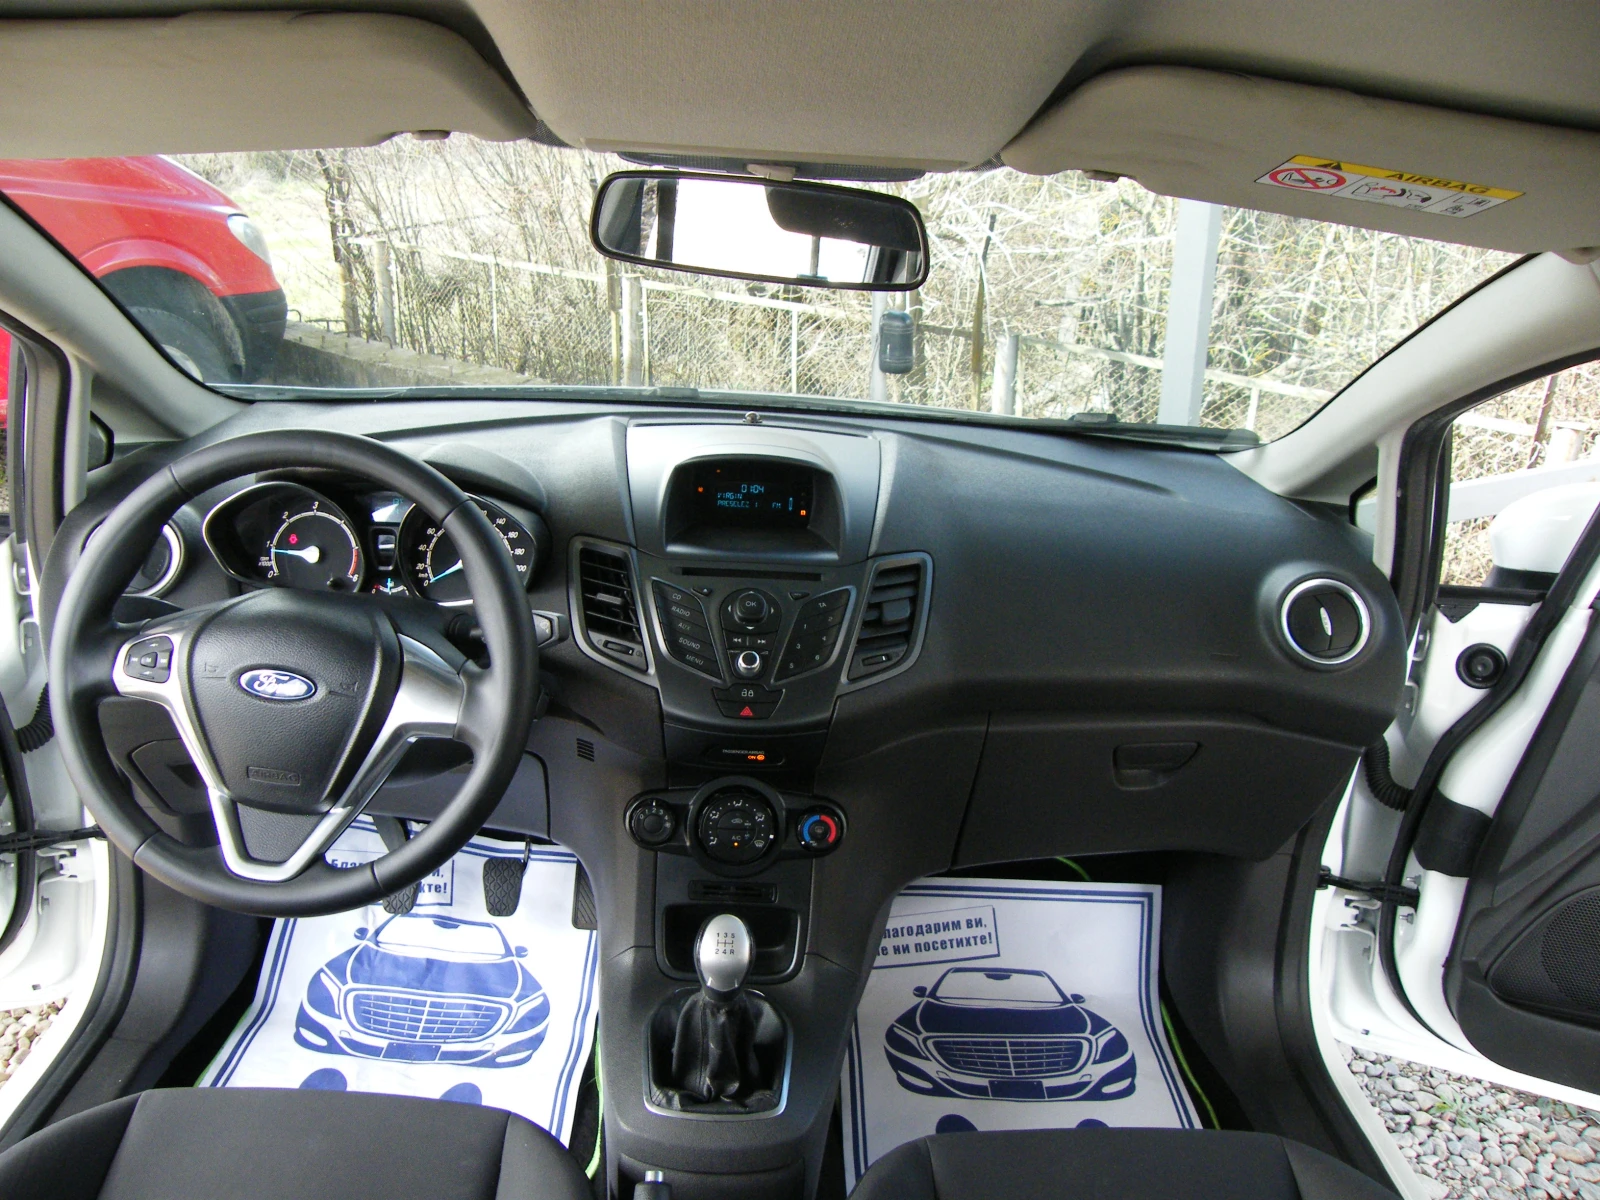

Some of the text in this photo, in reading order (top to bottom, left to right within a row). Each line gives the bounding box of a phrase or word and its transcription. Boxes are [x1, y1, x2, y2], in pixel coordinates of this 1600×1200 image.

[1385, 173, 1490, 194] AIRBAG
[313, 501, 319, 509] 3
[282, 511, 288, 519] 2
[495, 517, 507, 525] 140
[268, 570, 274, 578] 0
[353, 574, 359, 582] 6
[671, 605, 691, 617] RADIO
[678, 622, 690, 630] AUX
[678, 636, 701, 650] SOUND
[685, 654, 704, 666] MENU
[253, 672, 308, 697] Ford
[251, 769, 299, 783] AIRBAG
[882, 917, 987, 939] лагодарим ви,
[892, 943, 910, 954] ни
[914, 932, 993, 953] посетихте!
